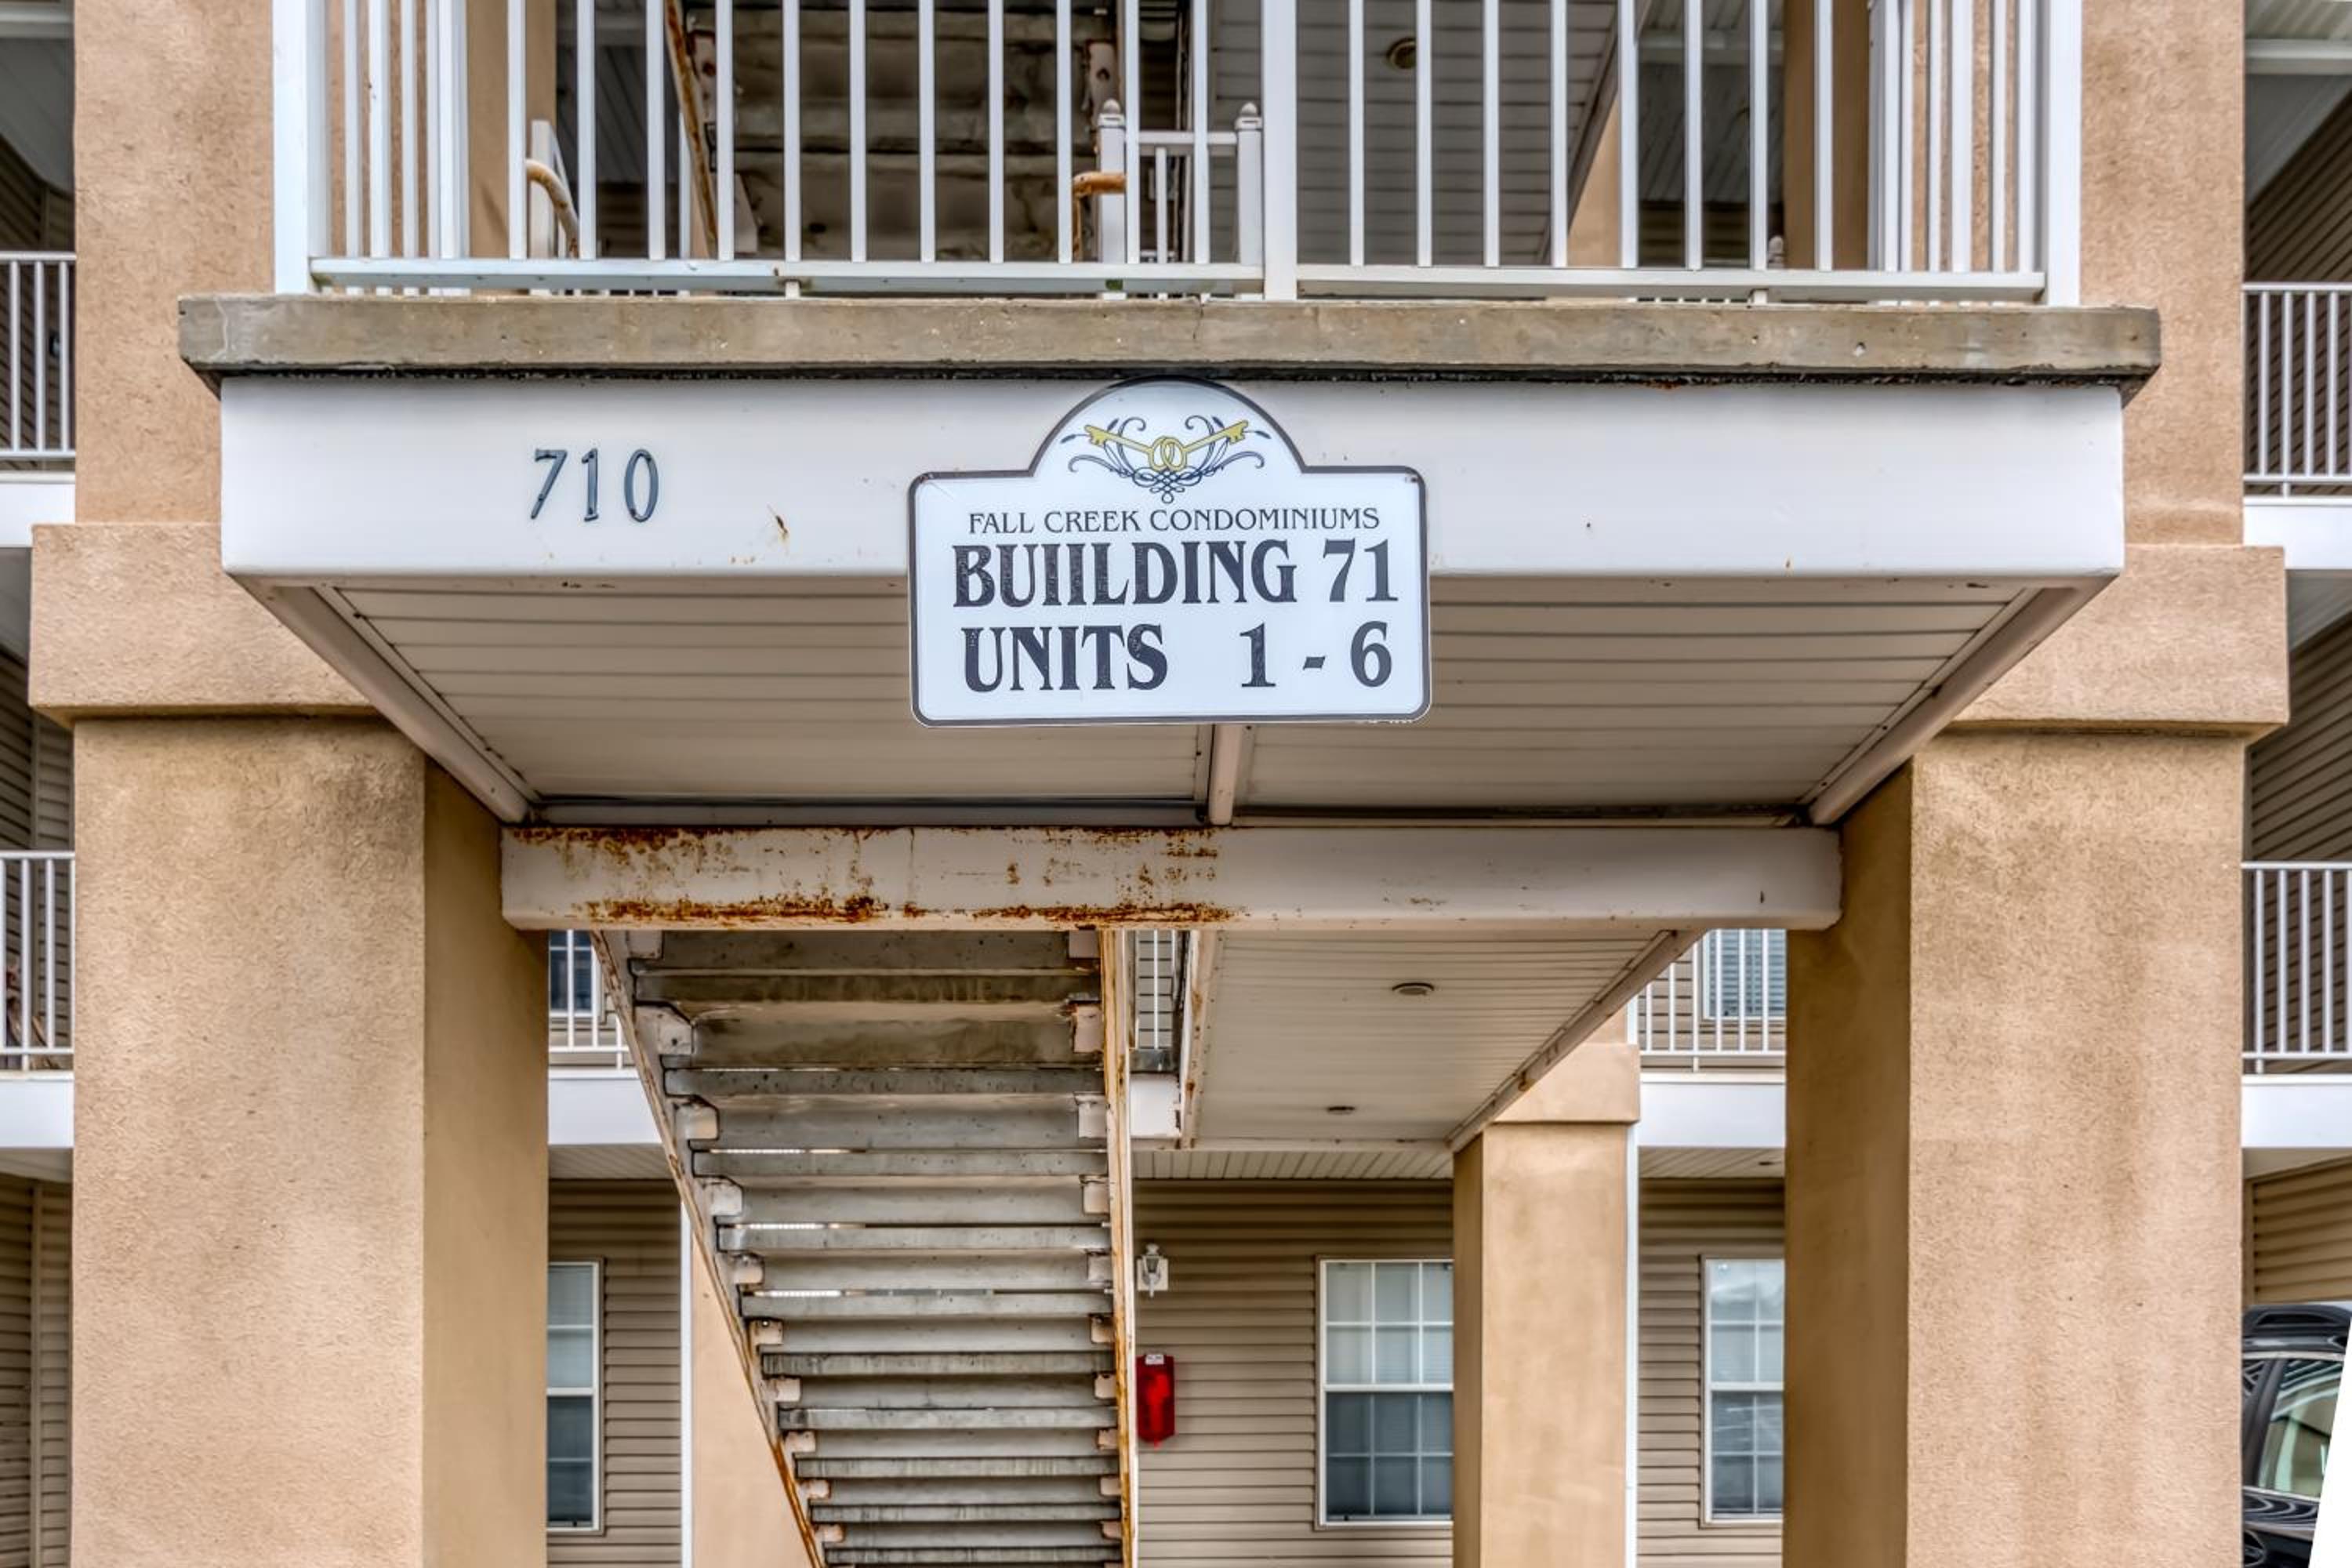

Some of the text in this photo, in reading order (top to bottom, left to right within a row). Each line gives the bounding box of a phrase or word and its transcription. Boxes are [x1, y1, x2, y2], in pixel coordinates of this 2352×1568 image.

[531, 448, 659, 523] 710
[968, 507, 1380, 534] FALL CREEK CONDOMINIUMS
[952, 538, 1399, 608] BUIILDING 71
[961, 624, 1168, 692] UNITS
[1240, 622, 1276, 688] 1
[1350, 621, 1392, 688] 6
